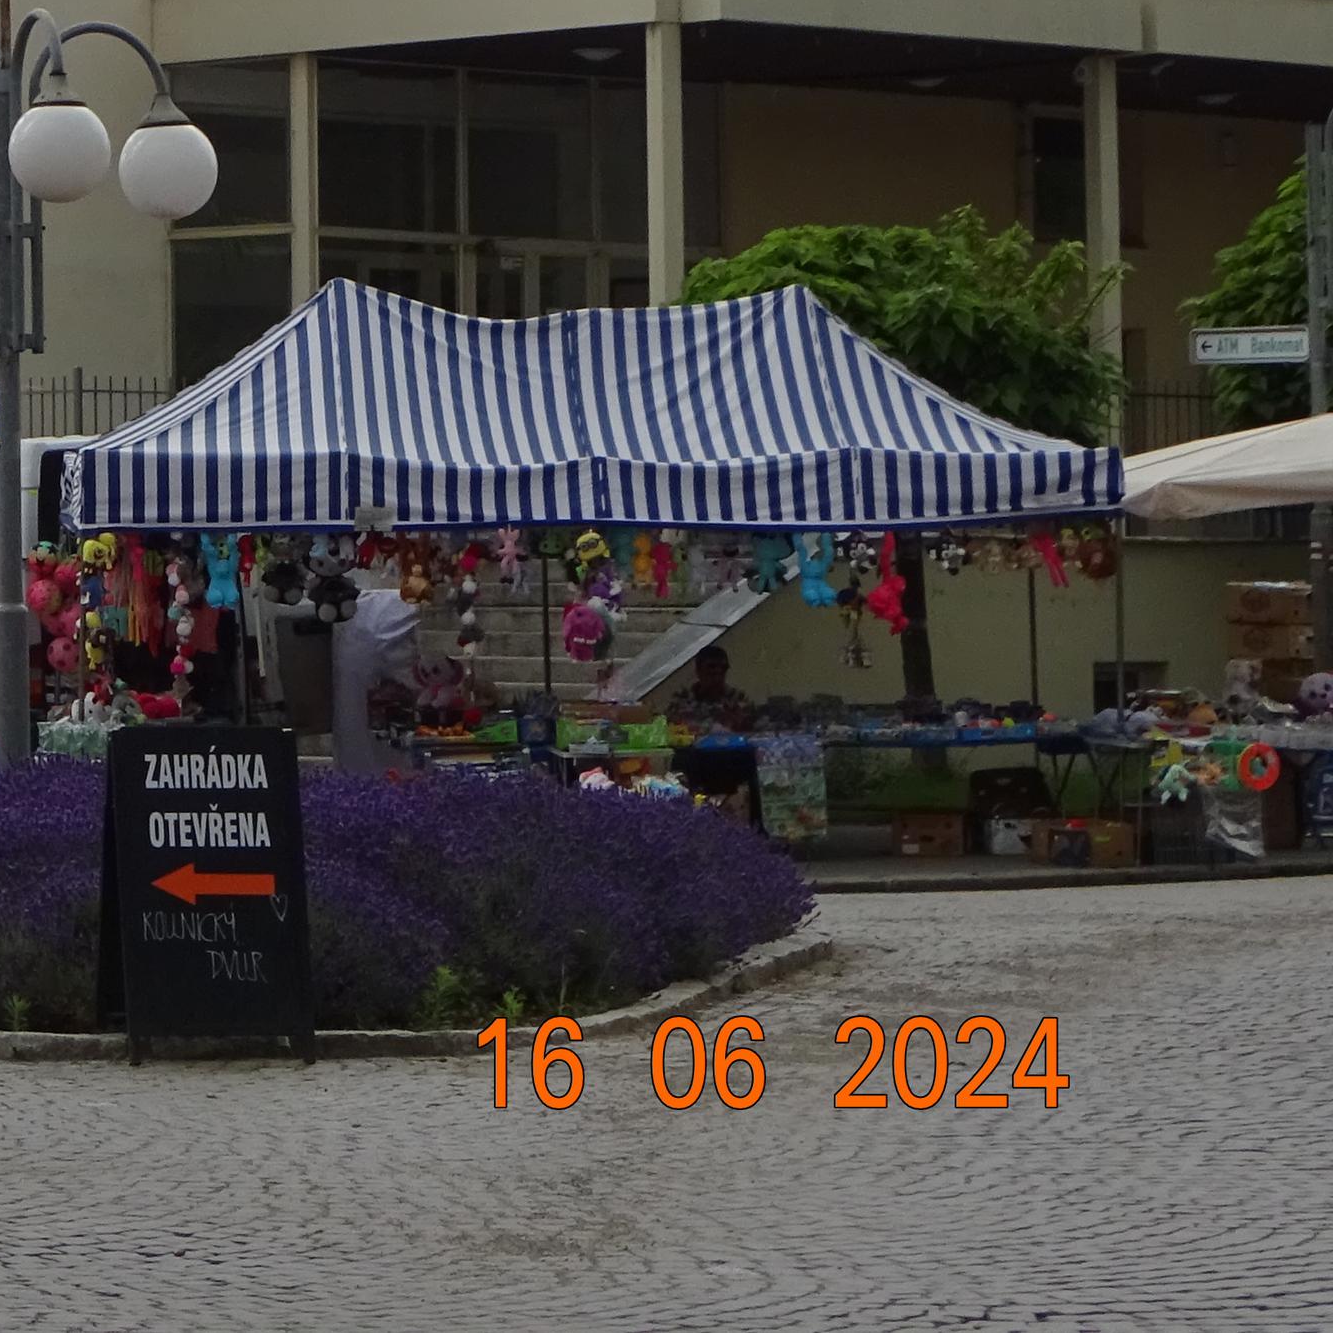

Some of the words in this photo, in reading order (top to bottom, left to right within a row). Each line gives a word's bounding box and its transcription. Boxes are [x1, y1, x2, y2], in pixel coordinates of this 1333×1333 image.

[1216, 338, 1239, 354] ATM
[1250, 336, 1304, 353] Bankomat
[144, 745, 269, 789] ZAHRÁDKA
[149, 803, 271, 848] OTEVŘENA
